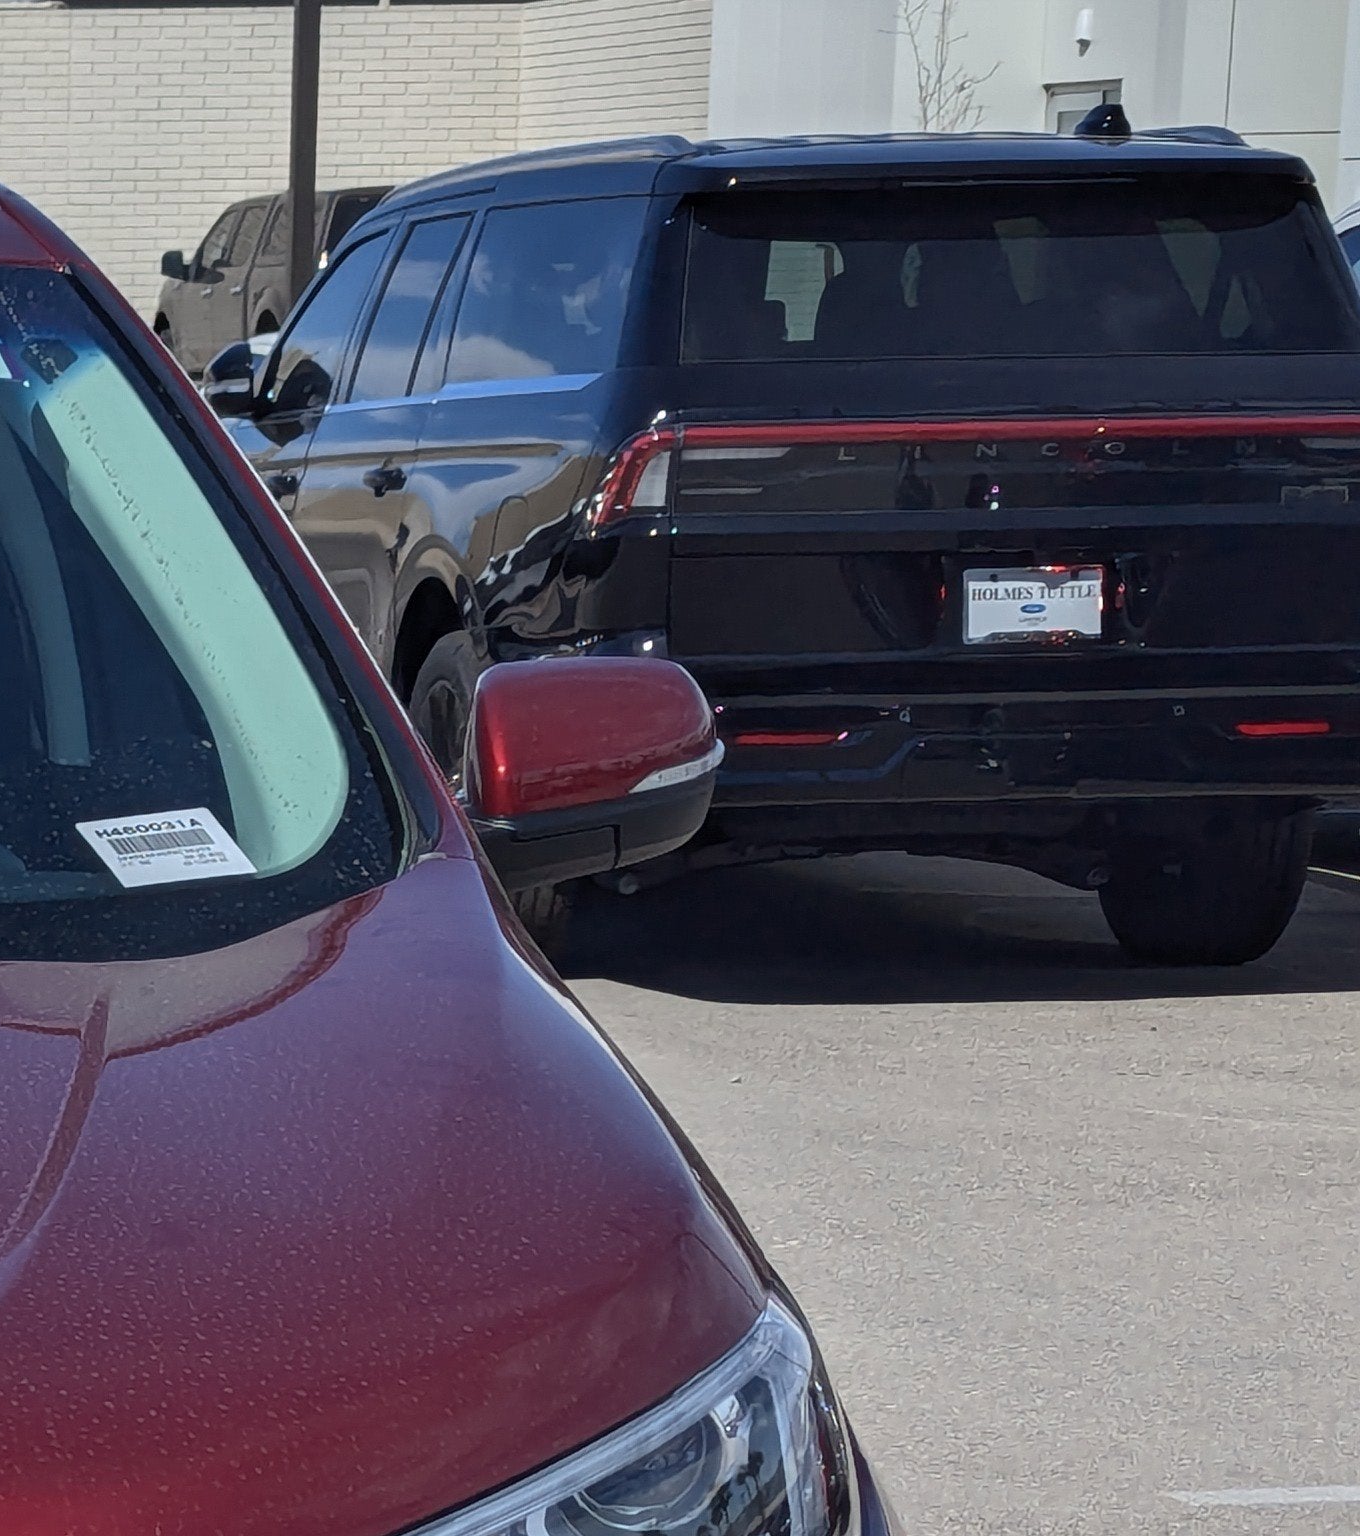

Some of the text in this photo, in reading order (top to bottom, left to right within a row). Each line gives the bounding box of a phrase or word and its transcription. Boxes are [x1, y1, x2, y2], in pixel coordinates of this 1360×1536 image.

[837, 440, 1257, 461] LINCOLN
[972, 584, 1097, 601] HOLMES TUTTLE
